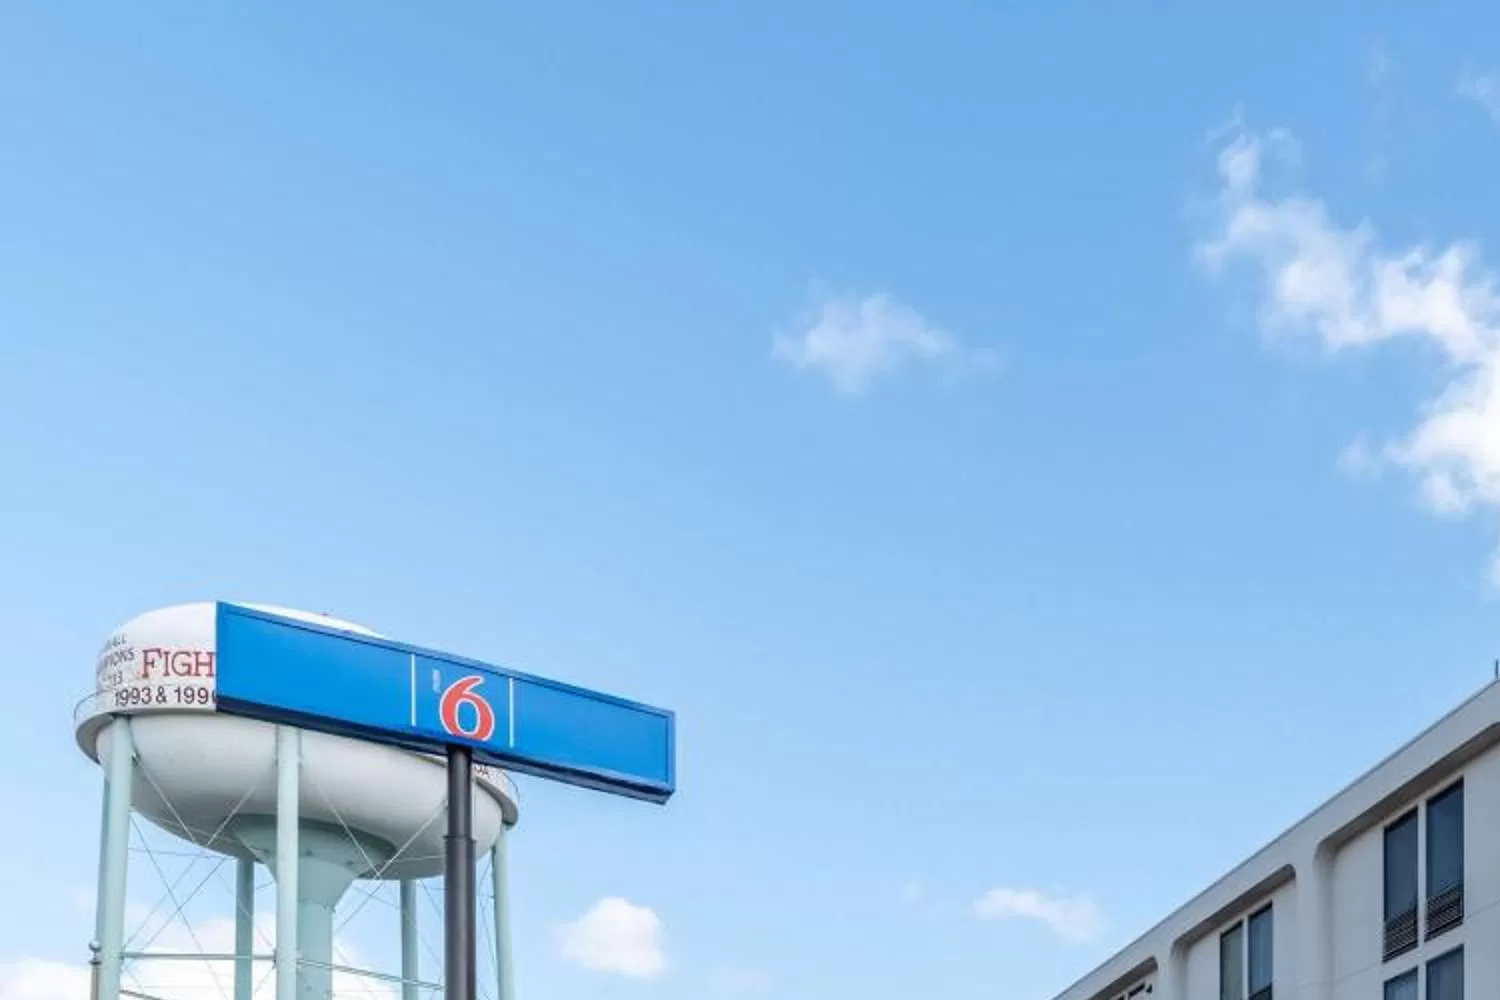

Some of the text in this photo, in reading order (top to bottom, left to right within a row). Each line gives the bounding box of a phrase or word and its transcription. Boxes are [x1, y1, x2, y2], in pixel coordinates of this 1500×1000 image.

[115, 686, 152, 706] 1993
[155, 685, 167, 703] &
[440, 675, 495, 741] 6
